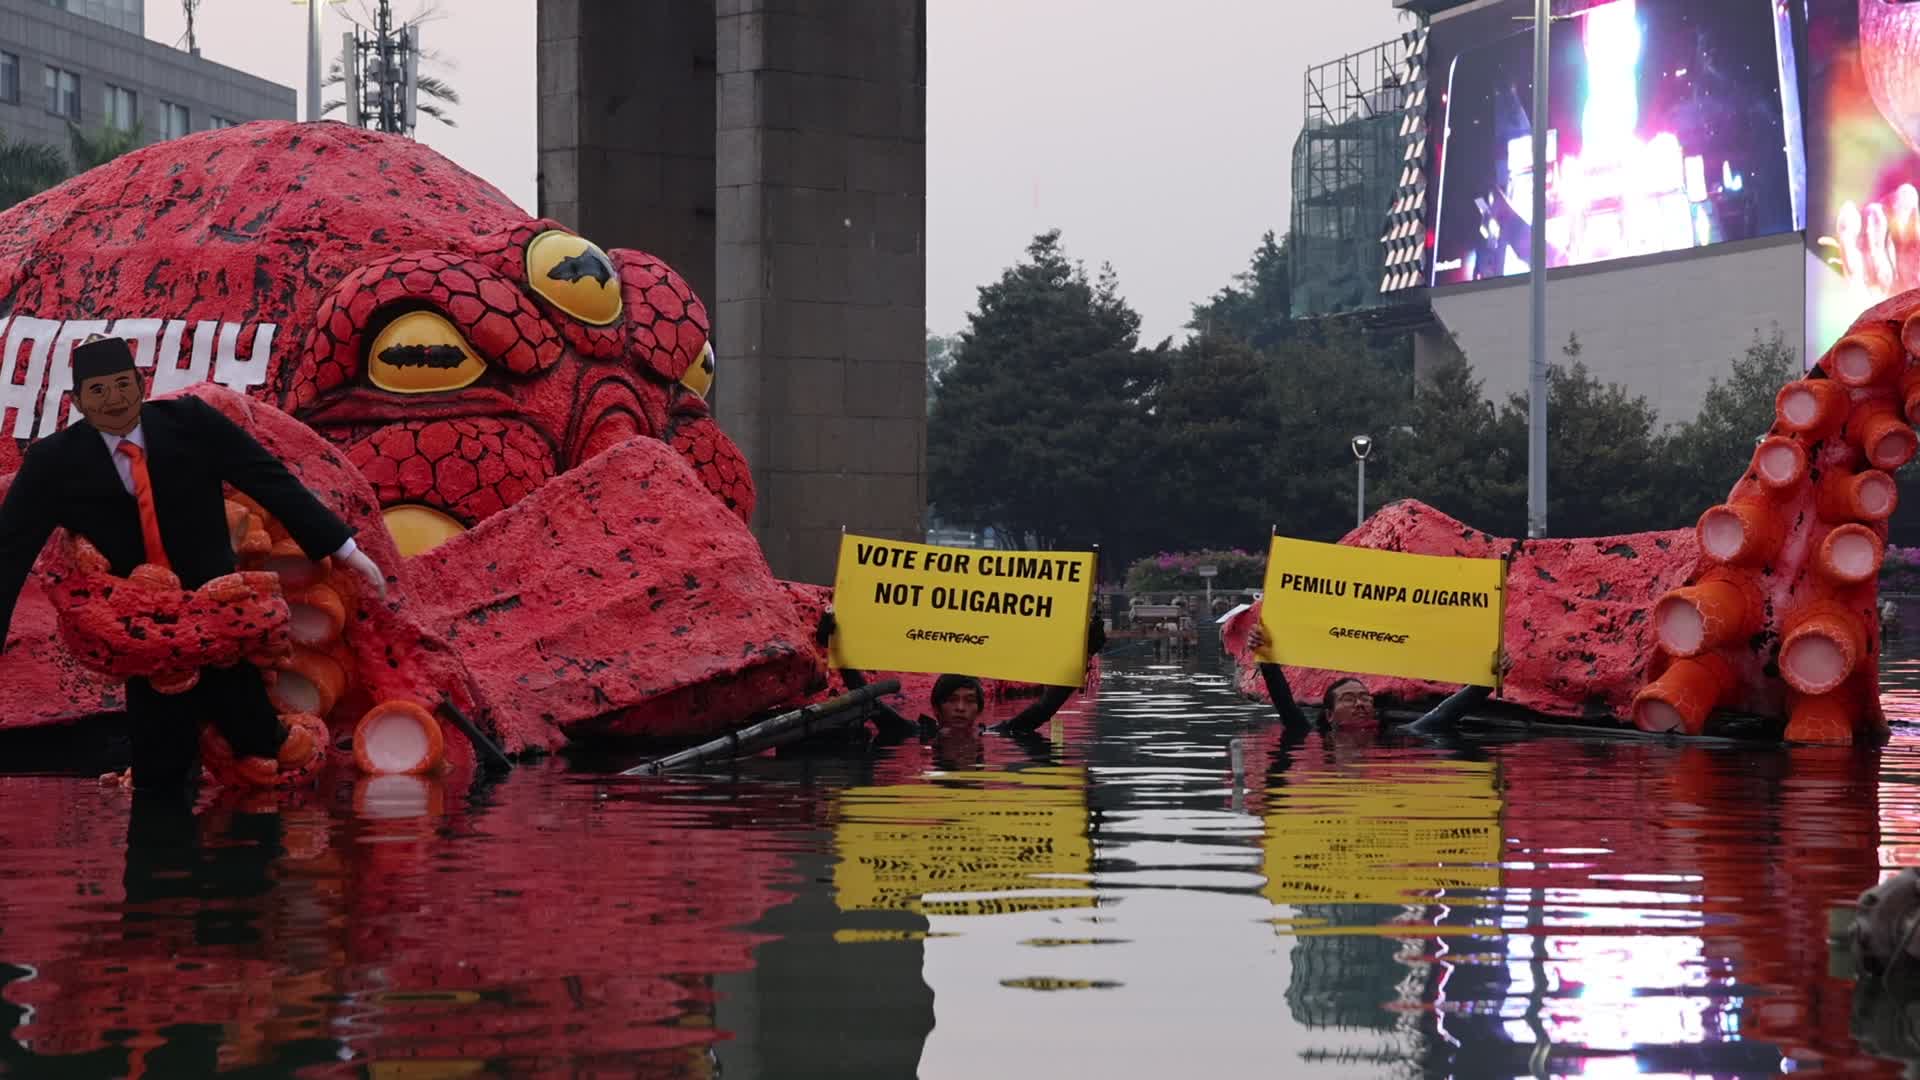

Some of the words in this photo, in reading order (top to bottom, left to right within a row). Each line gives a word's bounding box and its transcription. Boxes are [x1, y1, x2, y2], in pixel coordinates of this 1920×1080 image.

[857, 543, 917, 570] VOTE
[923, 552, 970, 575] FOR
[978, 555, 1082, 583] CLIMATE
[874, 582, 924, 607] NOT
[931, 586, 1053, 618] OLIGARCH
[1280, 573, 1347, 597] PEMILU
[1353, 582, 1407, 603] TANPA
[1411, 588, 1489, 609] OLIGARKI
[905, 628, 989, 645] GREENPEACE
[1328, 627, 1409, 644] GREENPEACE
